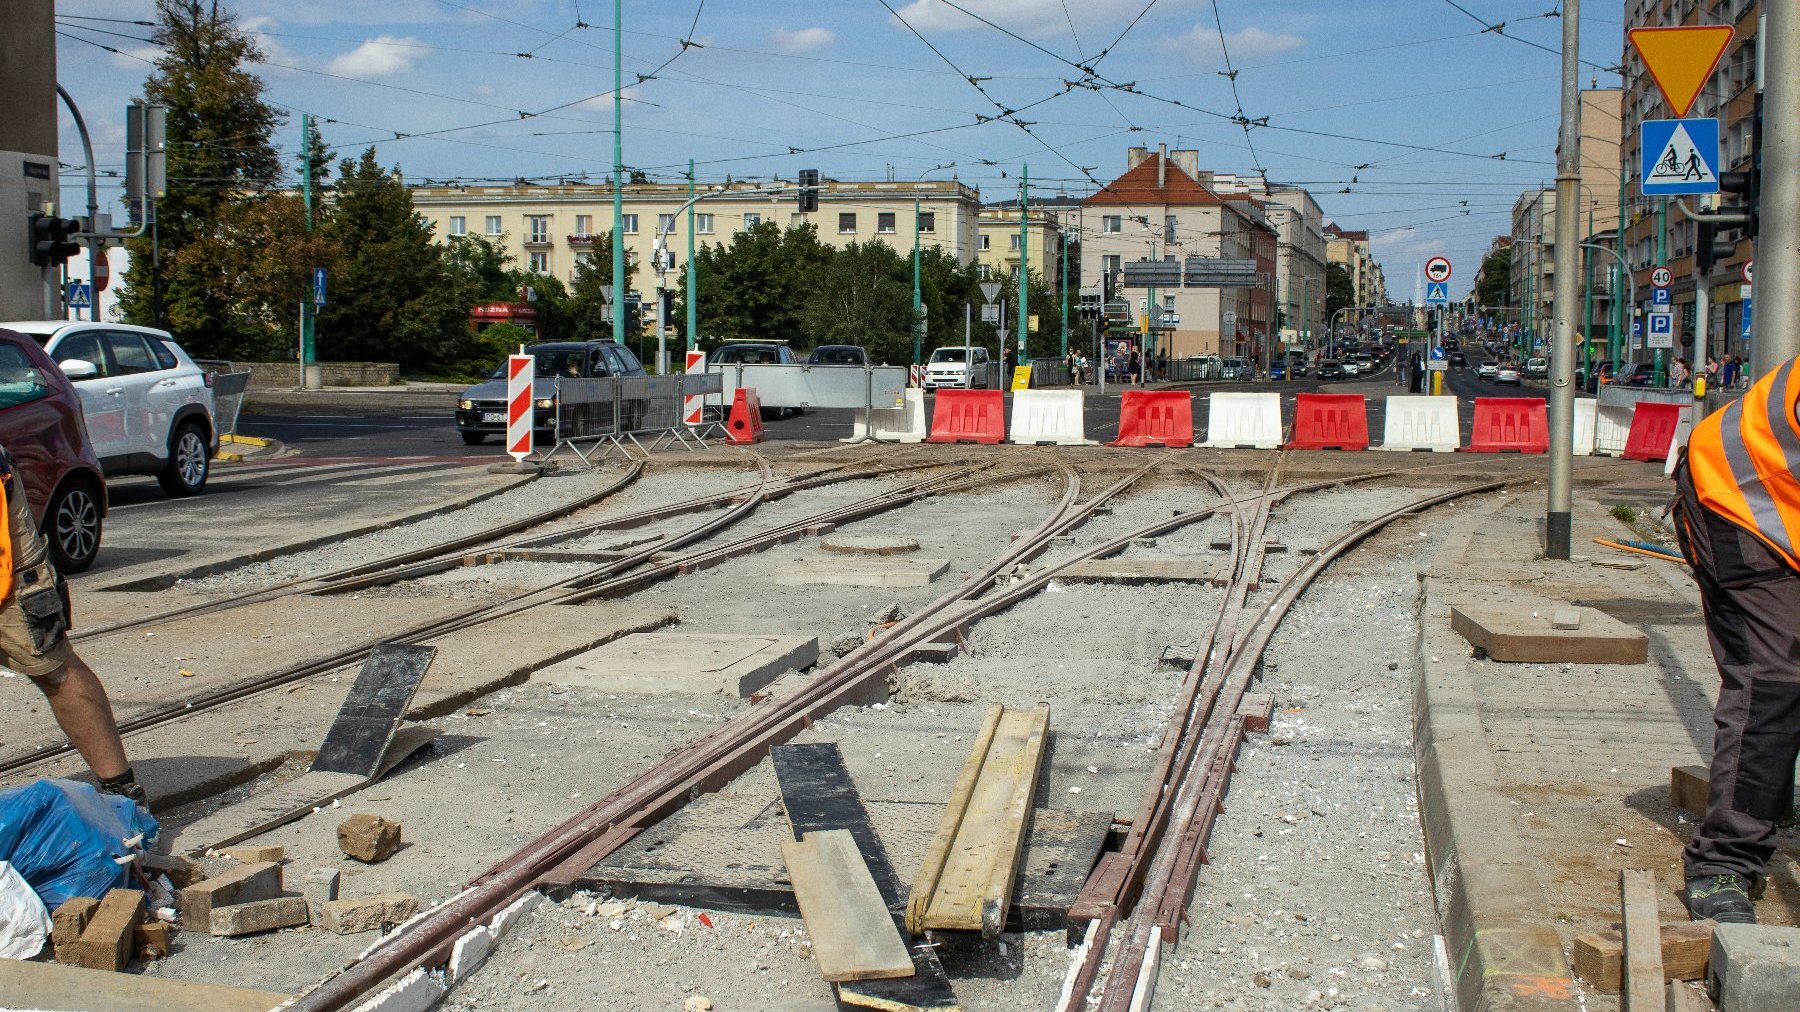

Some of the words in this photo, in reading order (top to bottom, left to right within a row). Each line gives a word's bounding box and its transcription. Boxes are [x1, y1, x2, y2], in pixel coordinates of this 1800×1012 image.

[1653, 271, 1670, 283] 40
[1656, 290, 1667, 303] P
[1655, 317, 1667, 331] P
